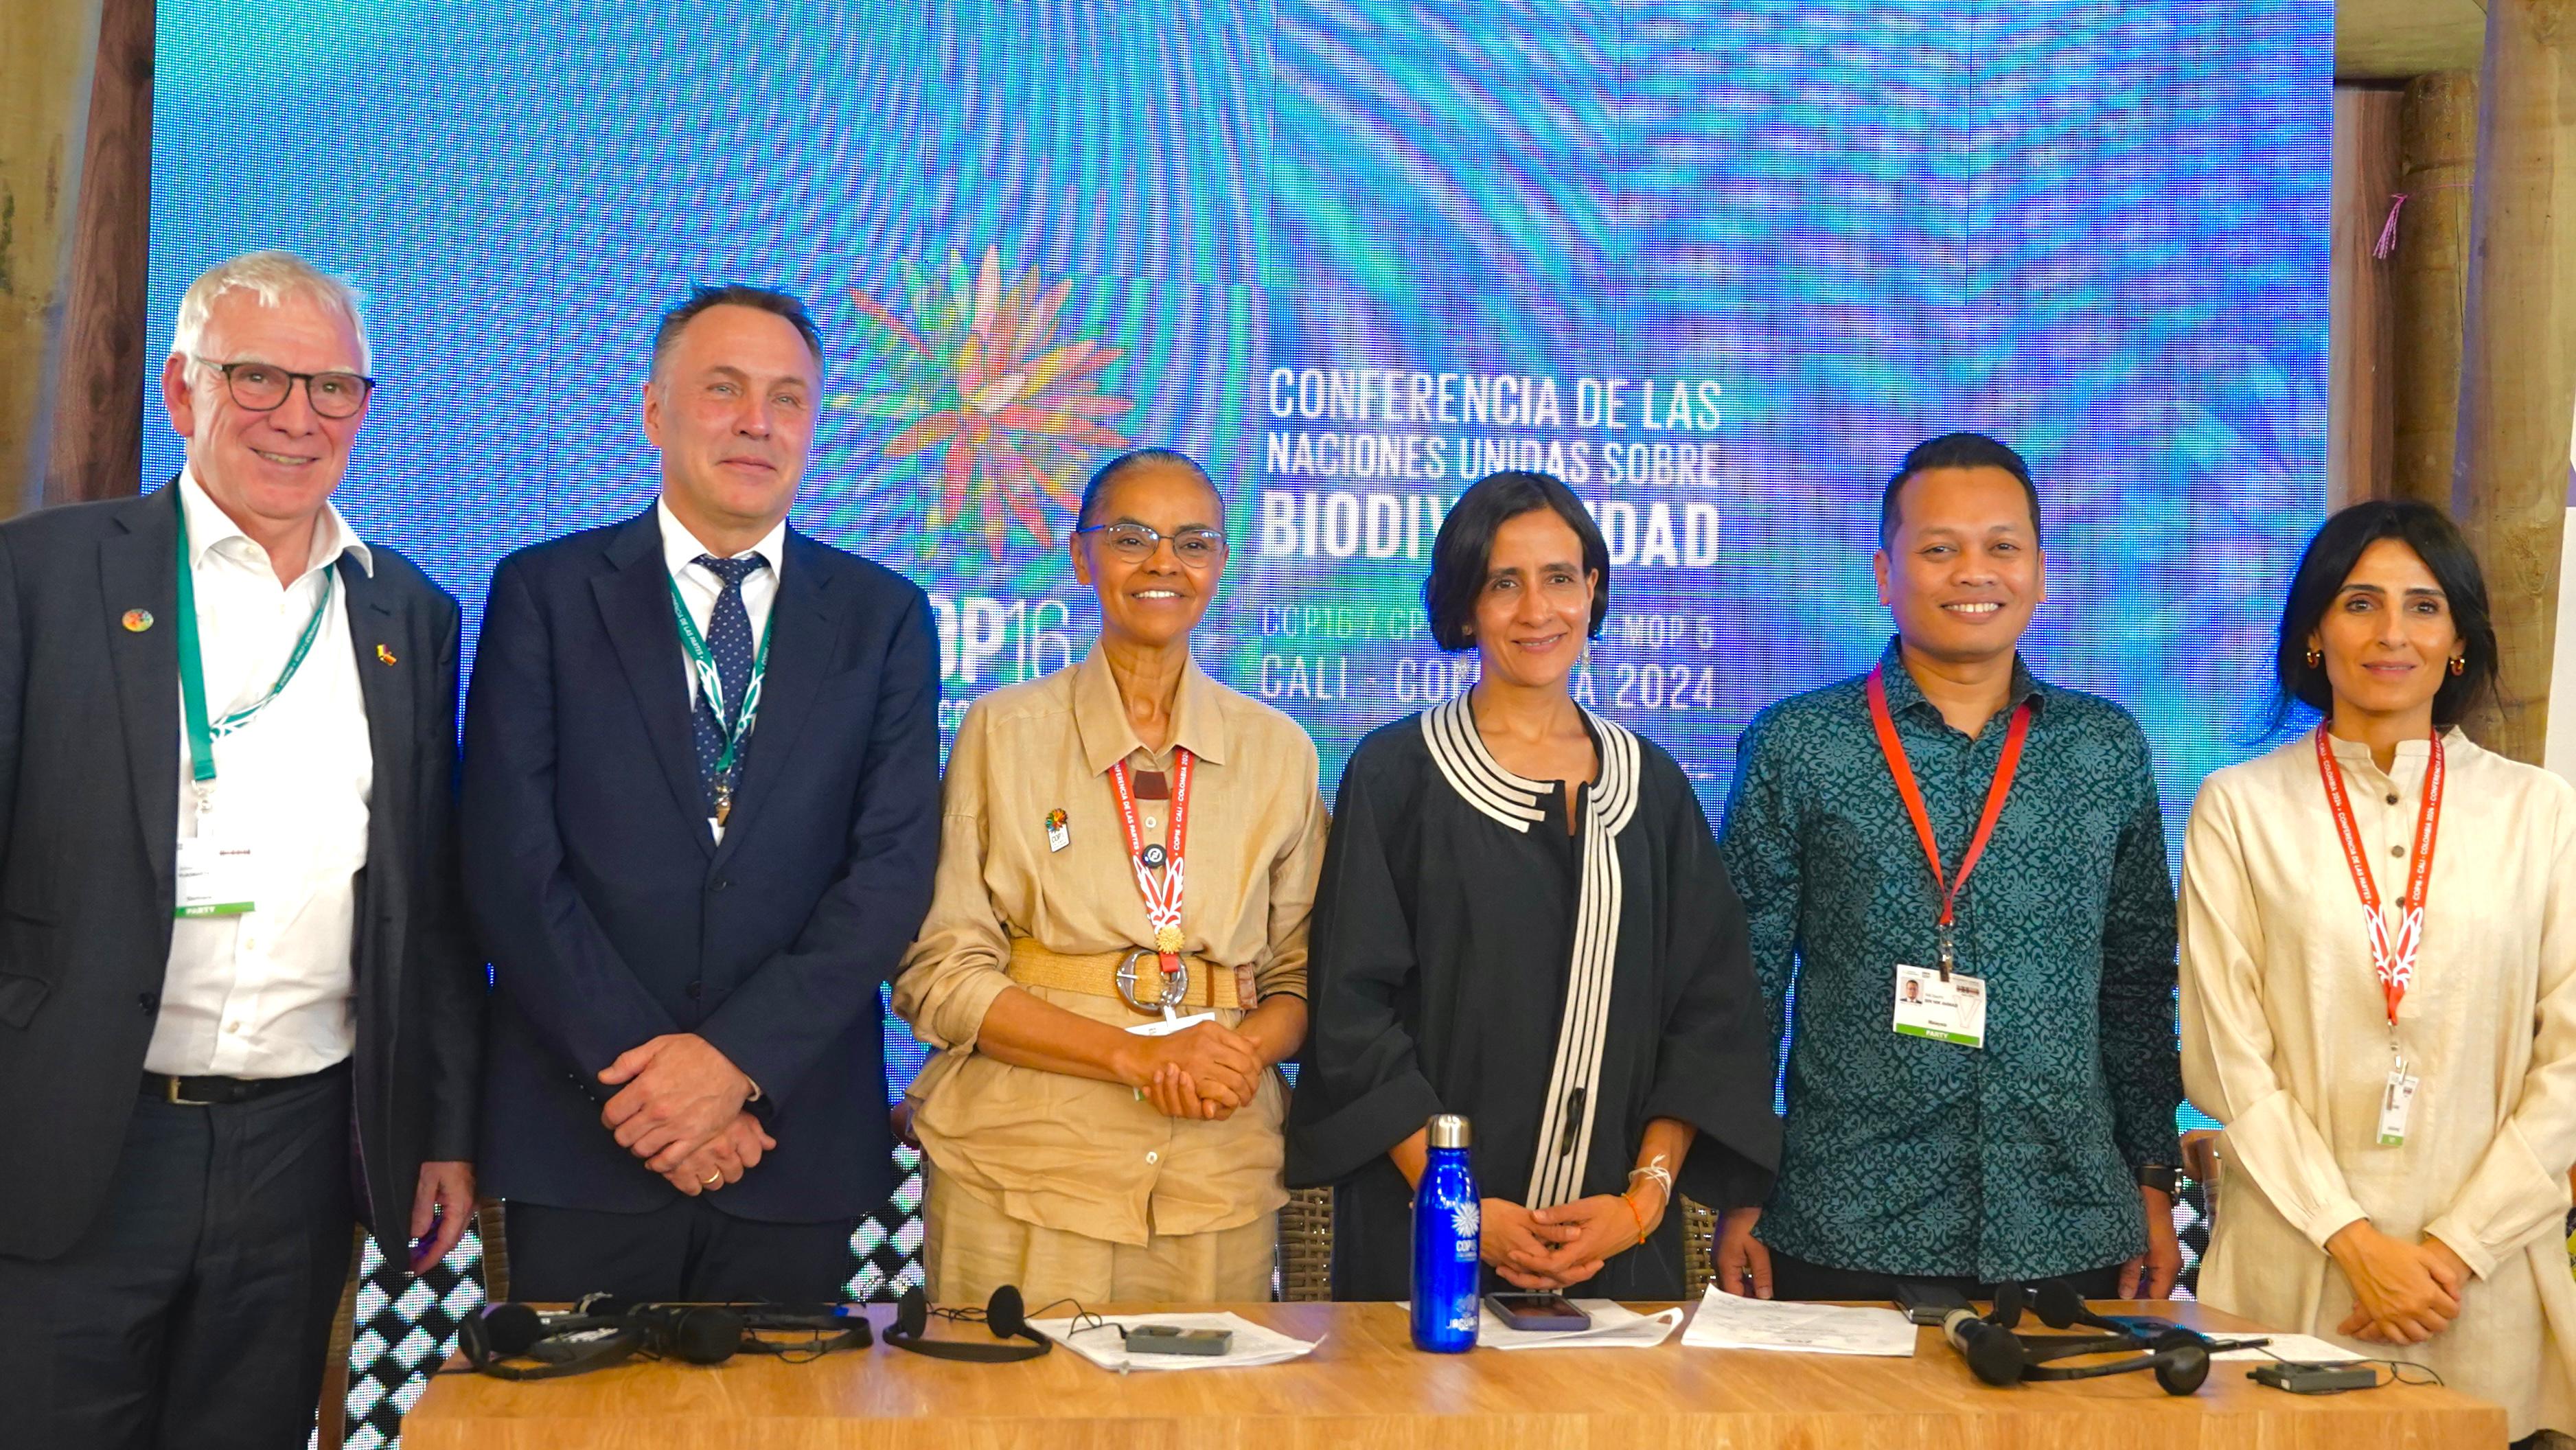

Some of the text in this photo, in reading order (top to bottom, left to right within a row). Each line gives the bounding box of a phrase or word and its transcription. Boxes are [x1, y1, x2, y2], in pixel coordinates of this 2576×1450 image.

[1269, 368, 1722, 430] CONFERENCIA DE LAS
[1267, 432, 1719, 487] NACIONES UNIDAS SOBRE
[1260, 655, 1347, 700] CALI
[1615, 663, 1715, 709] 2024
[1177, 766, 1187, 802] COLOMBIA
[1123, 801, 1131, 810] DE
[1125, 811, 1134, 824] LAS
[1175, 806, 1184, 822] CALI
[2323, 760, 2337, 792] COLOMBIA
[2338, 812, 2357, 855] CONFERENCIA
[1129, 824, 1139, 850] PARTES
[2420, 822, 2433, 855] COLOMBIA
[1925, 1029, 1948, 1039] PARTY
